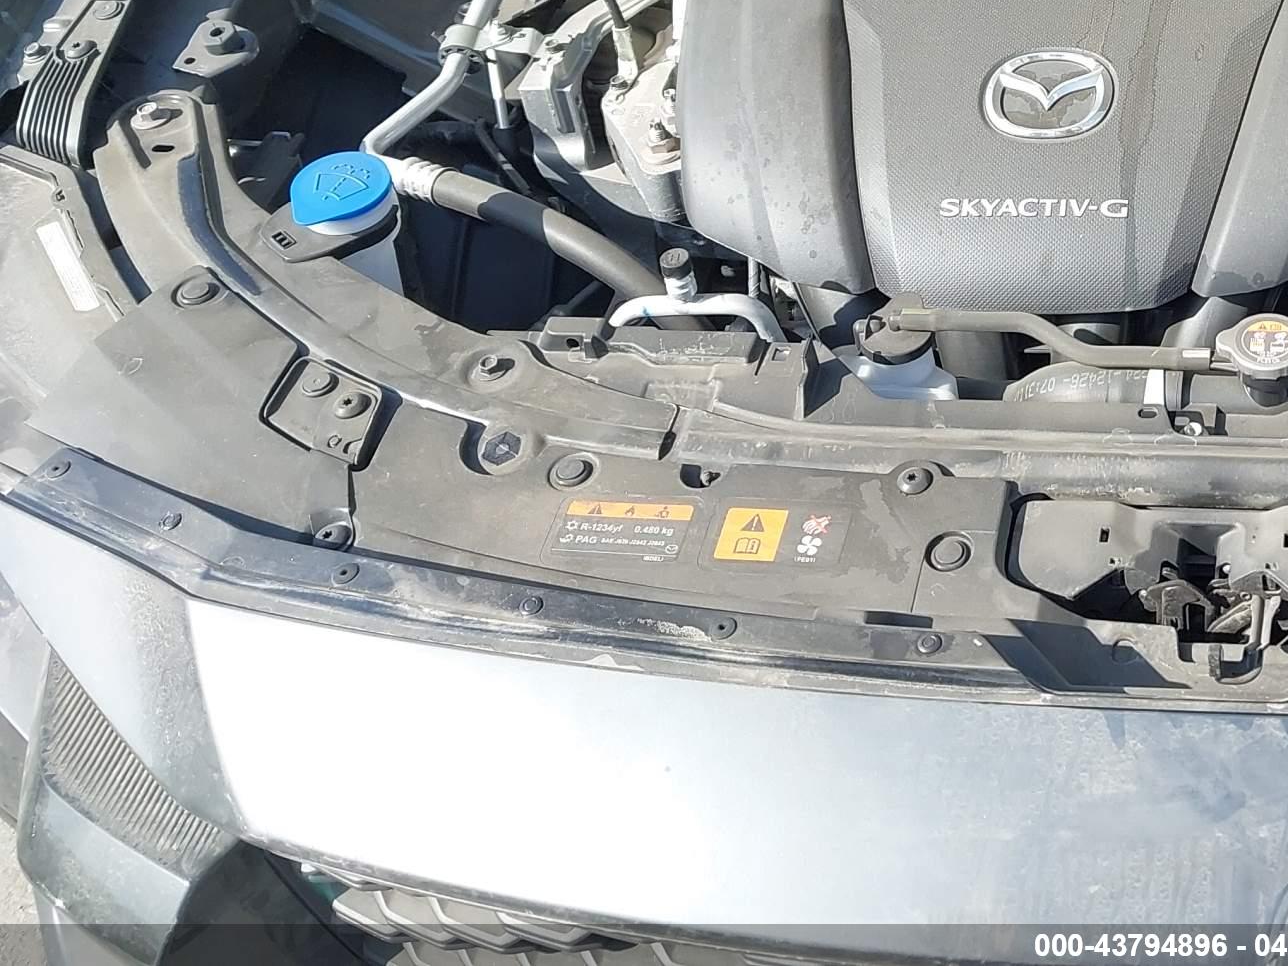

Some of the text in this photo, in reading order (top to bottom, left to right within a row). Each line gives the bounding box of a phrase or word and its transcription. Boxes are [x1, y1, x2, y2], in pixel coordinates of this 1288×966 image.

[939, 198, 1129, 219] SKYACTIV-G
[580, 522, 623, 534] R-1234yf
[661, 527, 674, 536] kg
[575, 534, 597, 544] PAG
